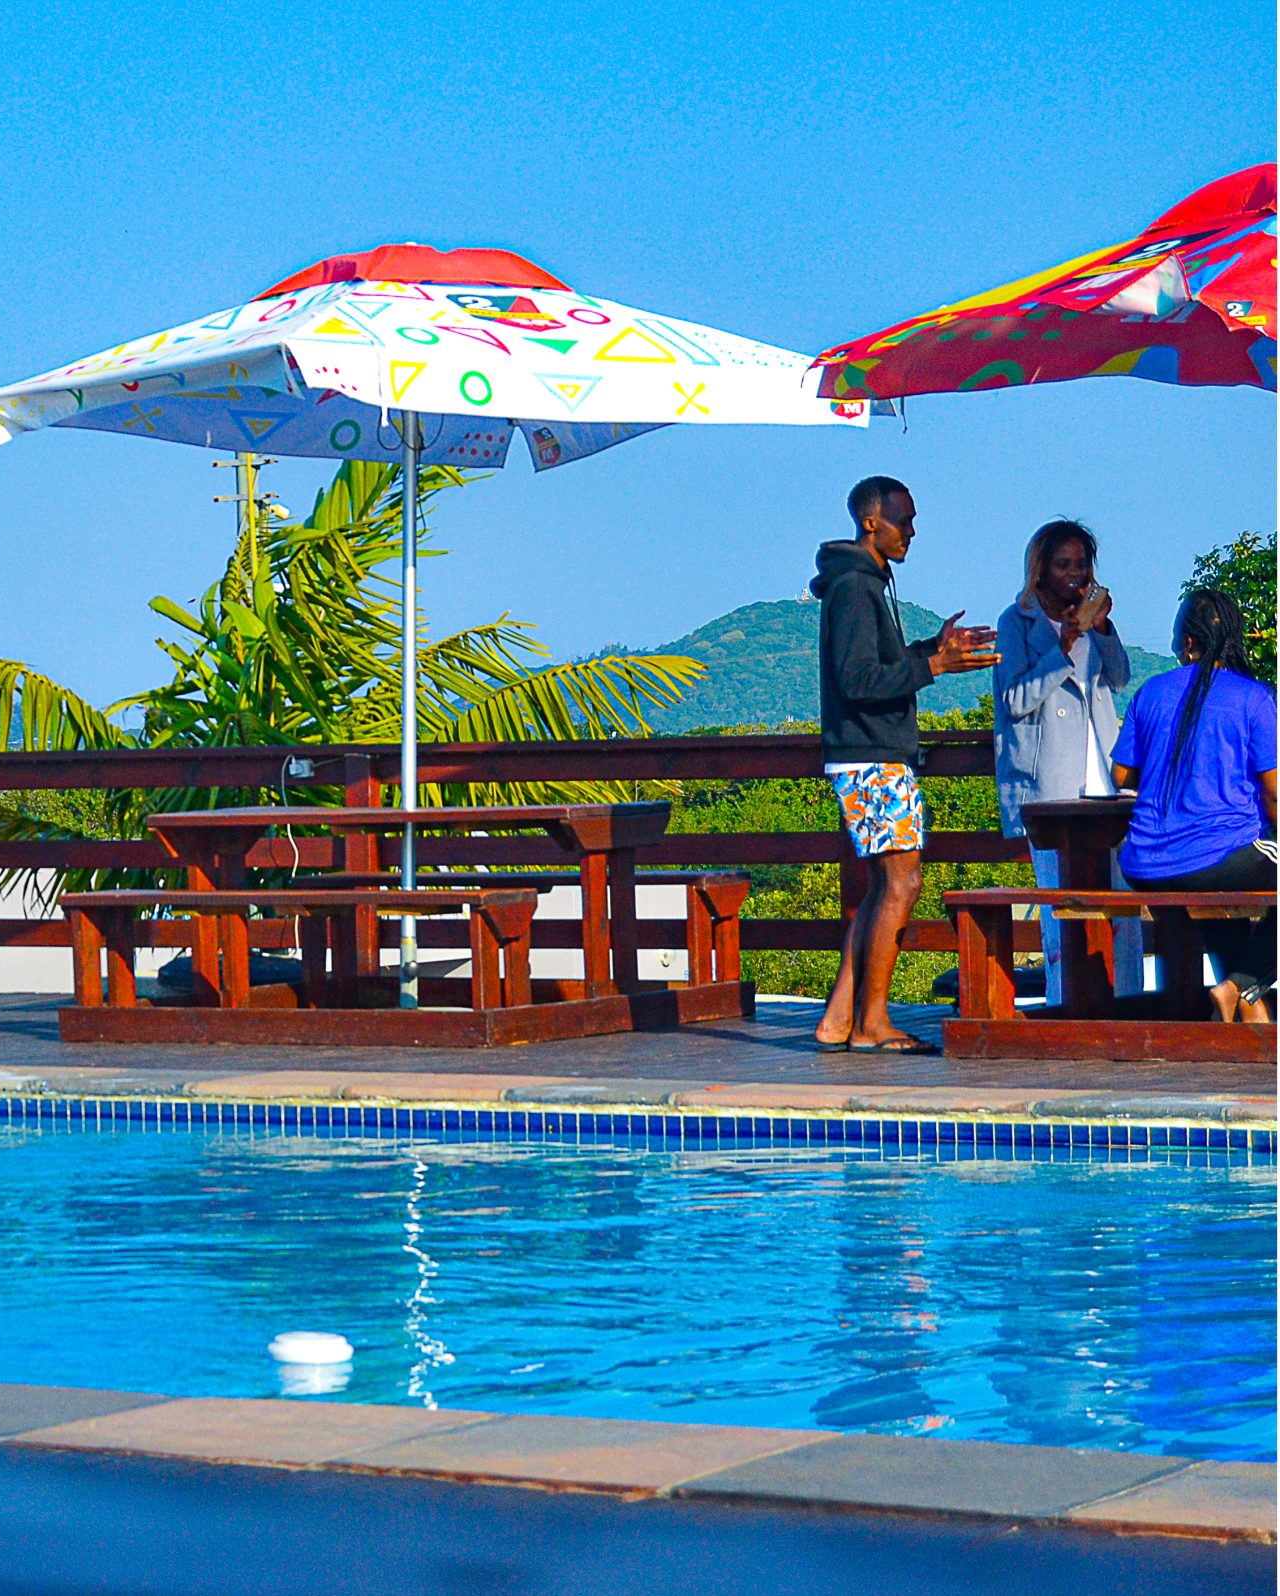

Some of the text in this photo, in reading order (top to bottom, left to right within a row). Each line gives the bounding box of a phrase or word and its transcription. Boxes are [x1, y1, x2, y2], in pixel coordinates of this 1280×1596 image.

[457, 296, 501, 313] 2
[1226, 302, 1245, 317] 2
[843, 402, 861, 414] M
